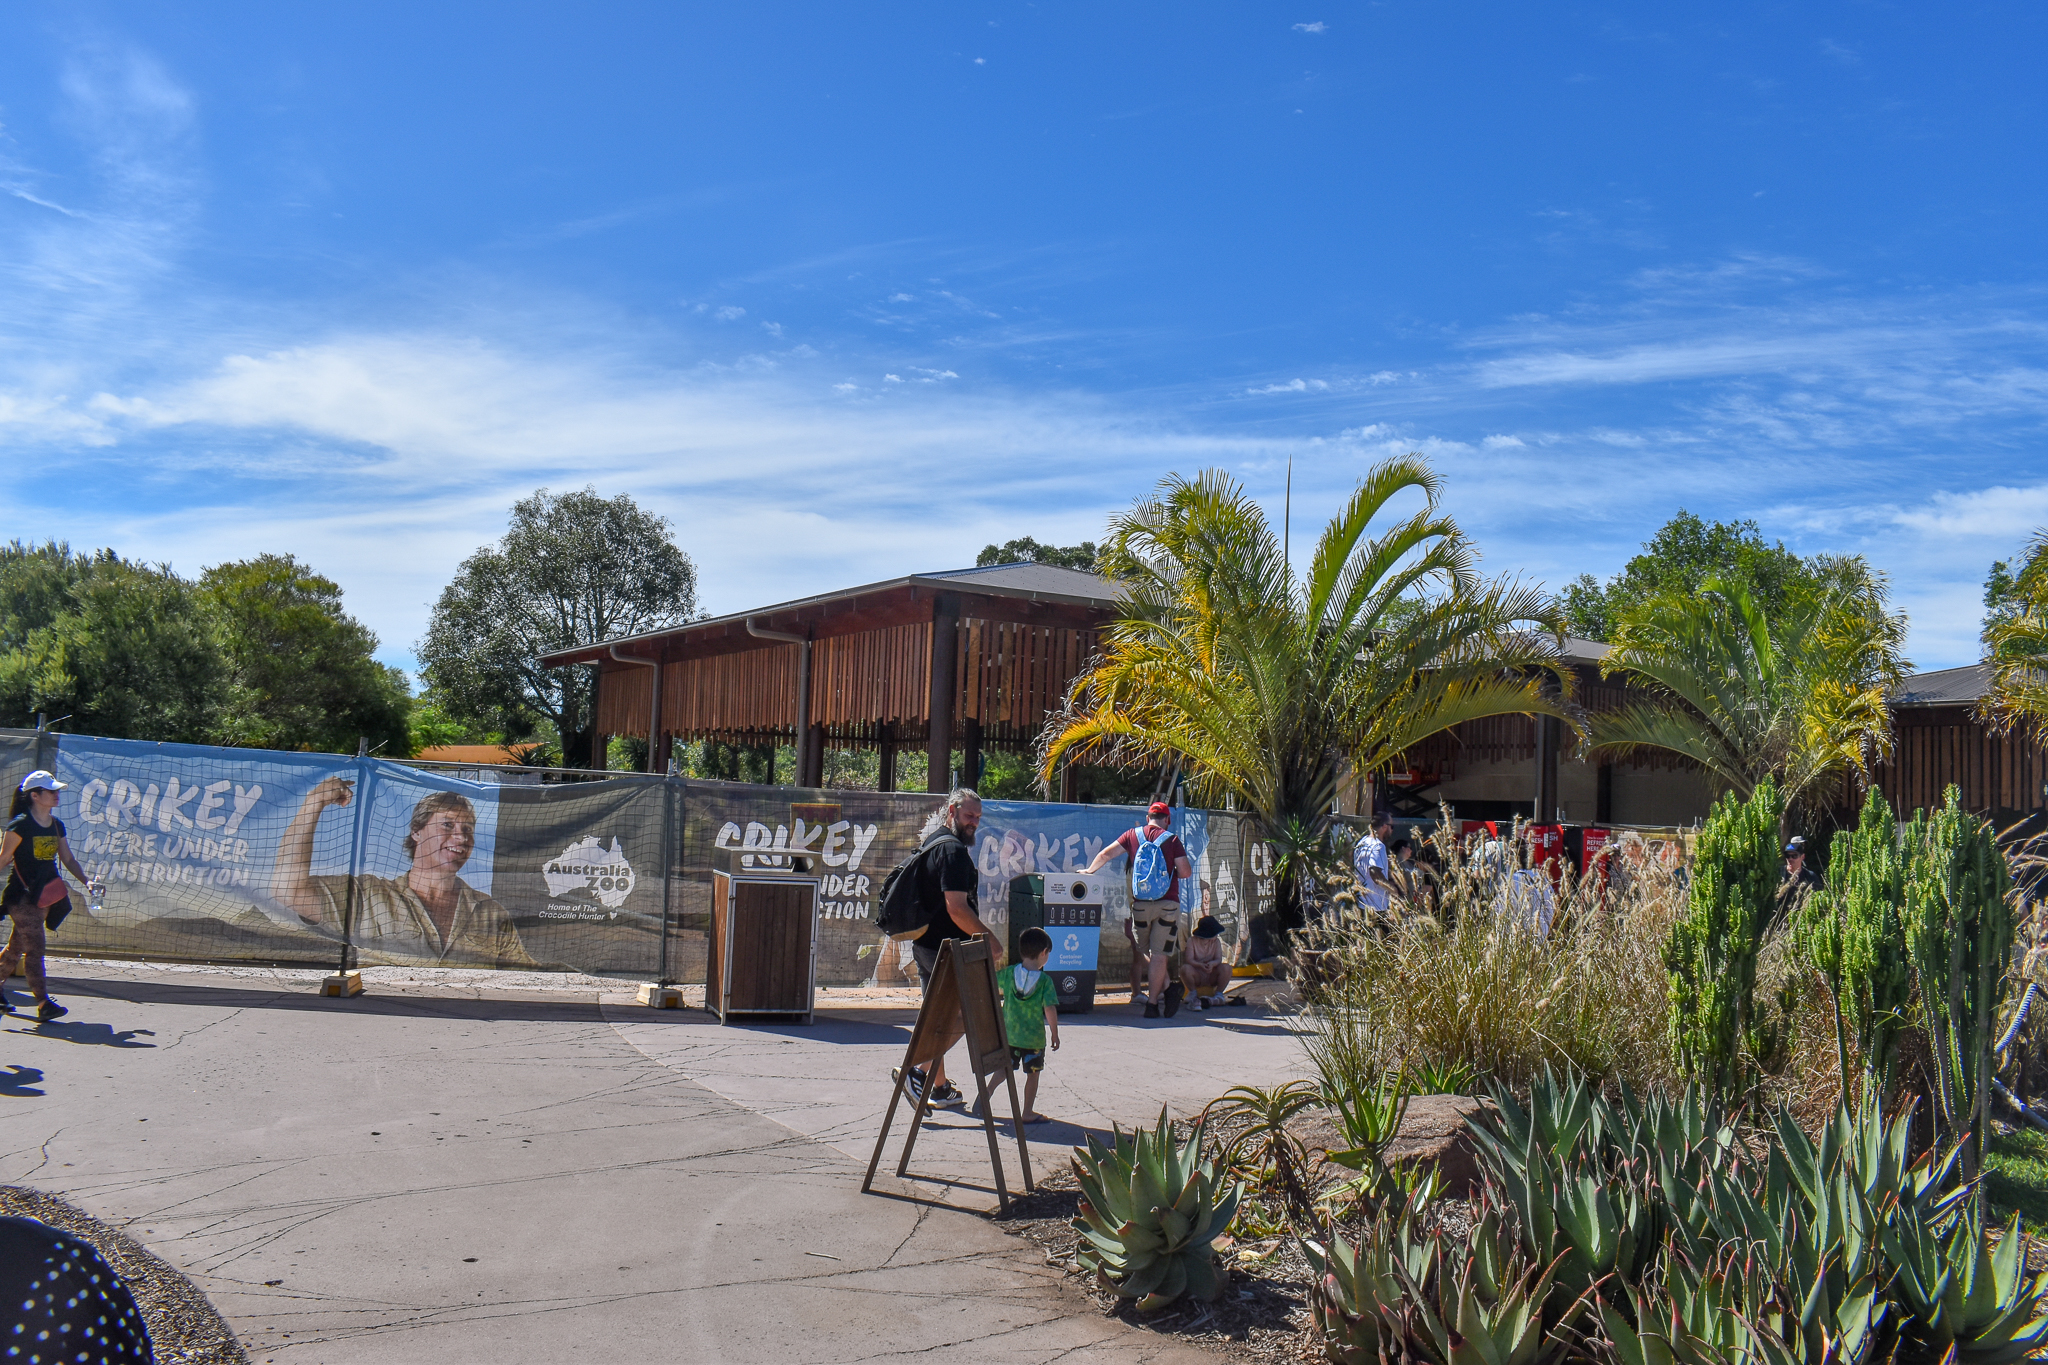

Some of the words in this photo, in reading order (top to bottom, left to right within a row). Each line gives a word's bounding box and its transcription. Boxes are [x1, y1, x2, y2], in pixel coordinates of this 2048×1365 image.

[79, 777, 263, 835] CRIKEY
[163, 835, 249, 863] UNDER
[715, 818, 878, 872] CRIKEY
[978, 832, 1103, 878] CRIKEY
[84, 859, 249, 886] CONSTRUCTION
[547, 863, 630, 876] Australia
[538, 910, 576, 919] Crocodile
[578, 911, 605, 920] Hunter
[547, 903, 570, 911] Home
[583, 904, 597, 912] The
